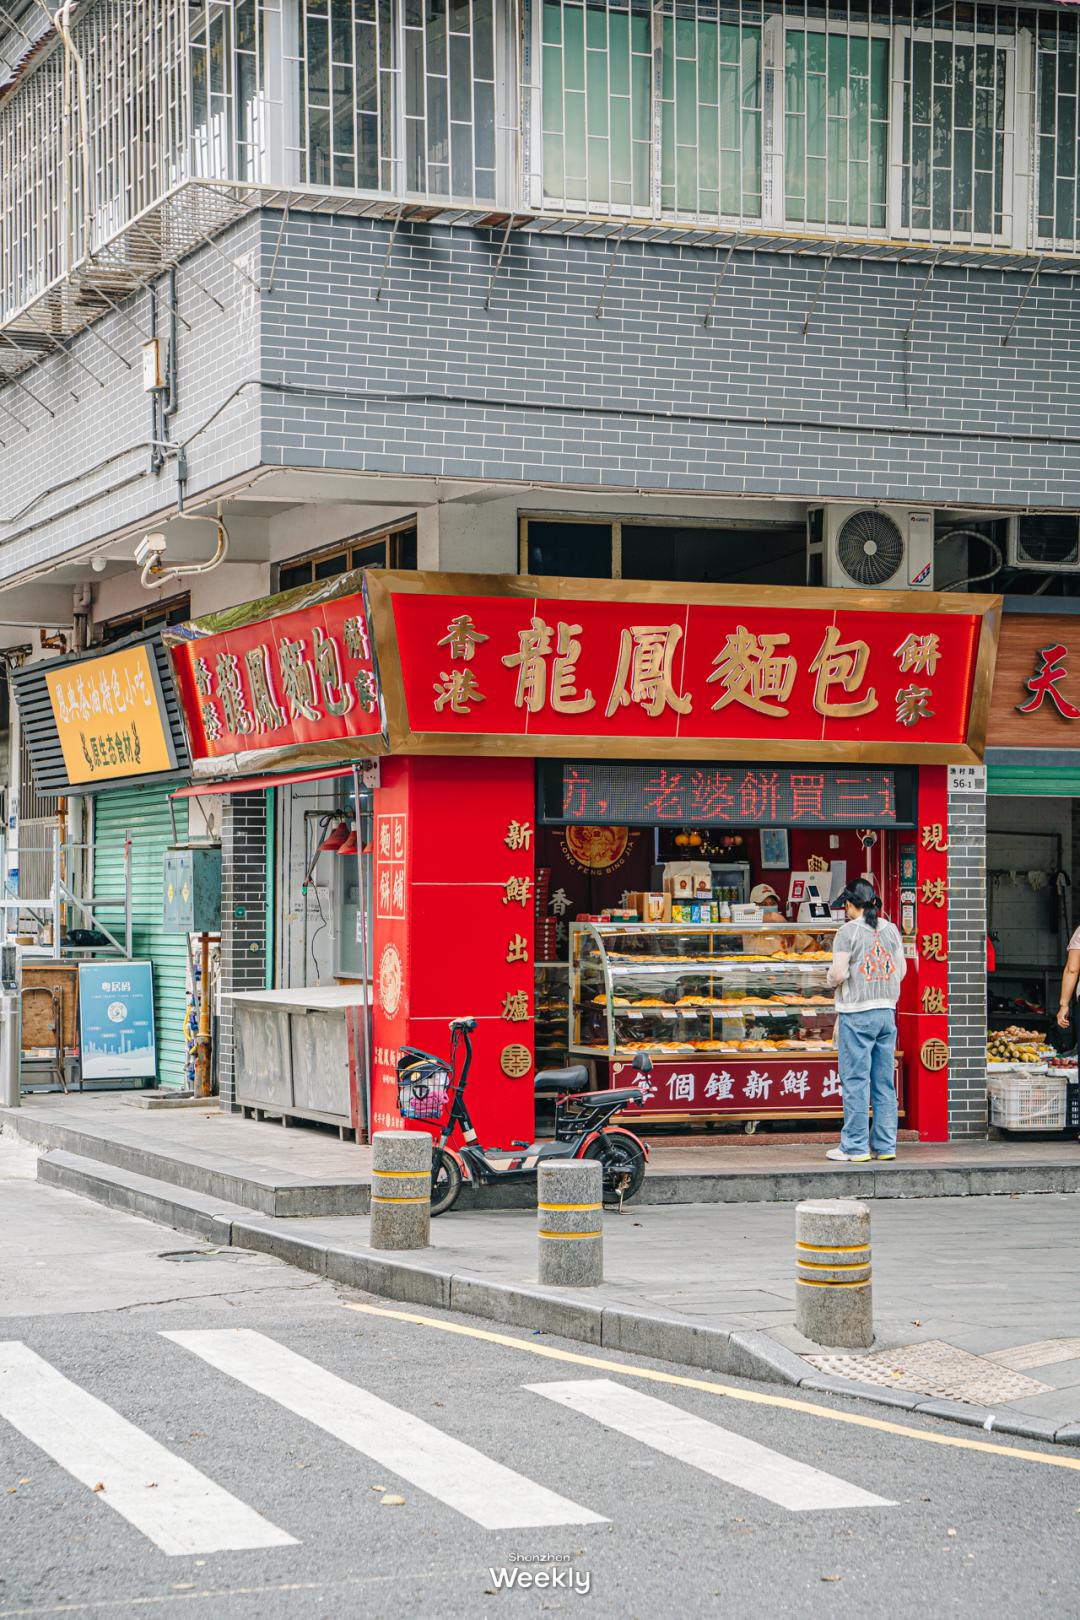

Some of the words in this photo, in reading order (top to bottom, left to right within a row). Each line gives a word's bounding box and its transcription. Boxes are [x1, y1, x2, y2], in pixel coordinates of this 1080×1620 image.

[433, 614, 490, 714] 香港
[501, 616, 879, 718] 龍鳳麵包
[893, 632, 942, 727] 餅家
[1016, 643, 1080, 719] 天
[953, 779, 972, 788] 56-1
[560, 841, 576, 865] LONG
[577, 865, 602, 876] FENG
[606, 859, 625, 874] BING
[626, 841, 634, 857] JIA
[501, 819, 533, 1023] 新鮮出爐
[920, 822, 948, 1015] 現烤現做
